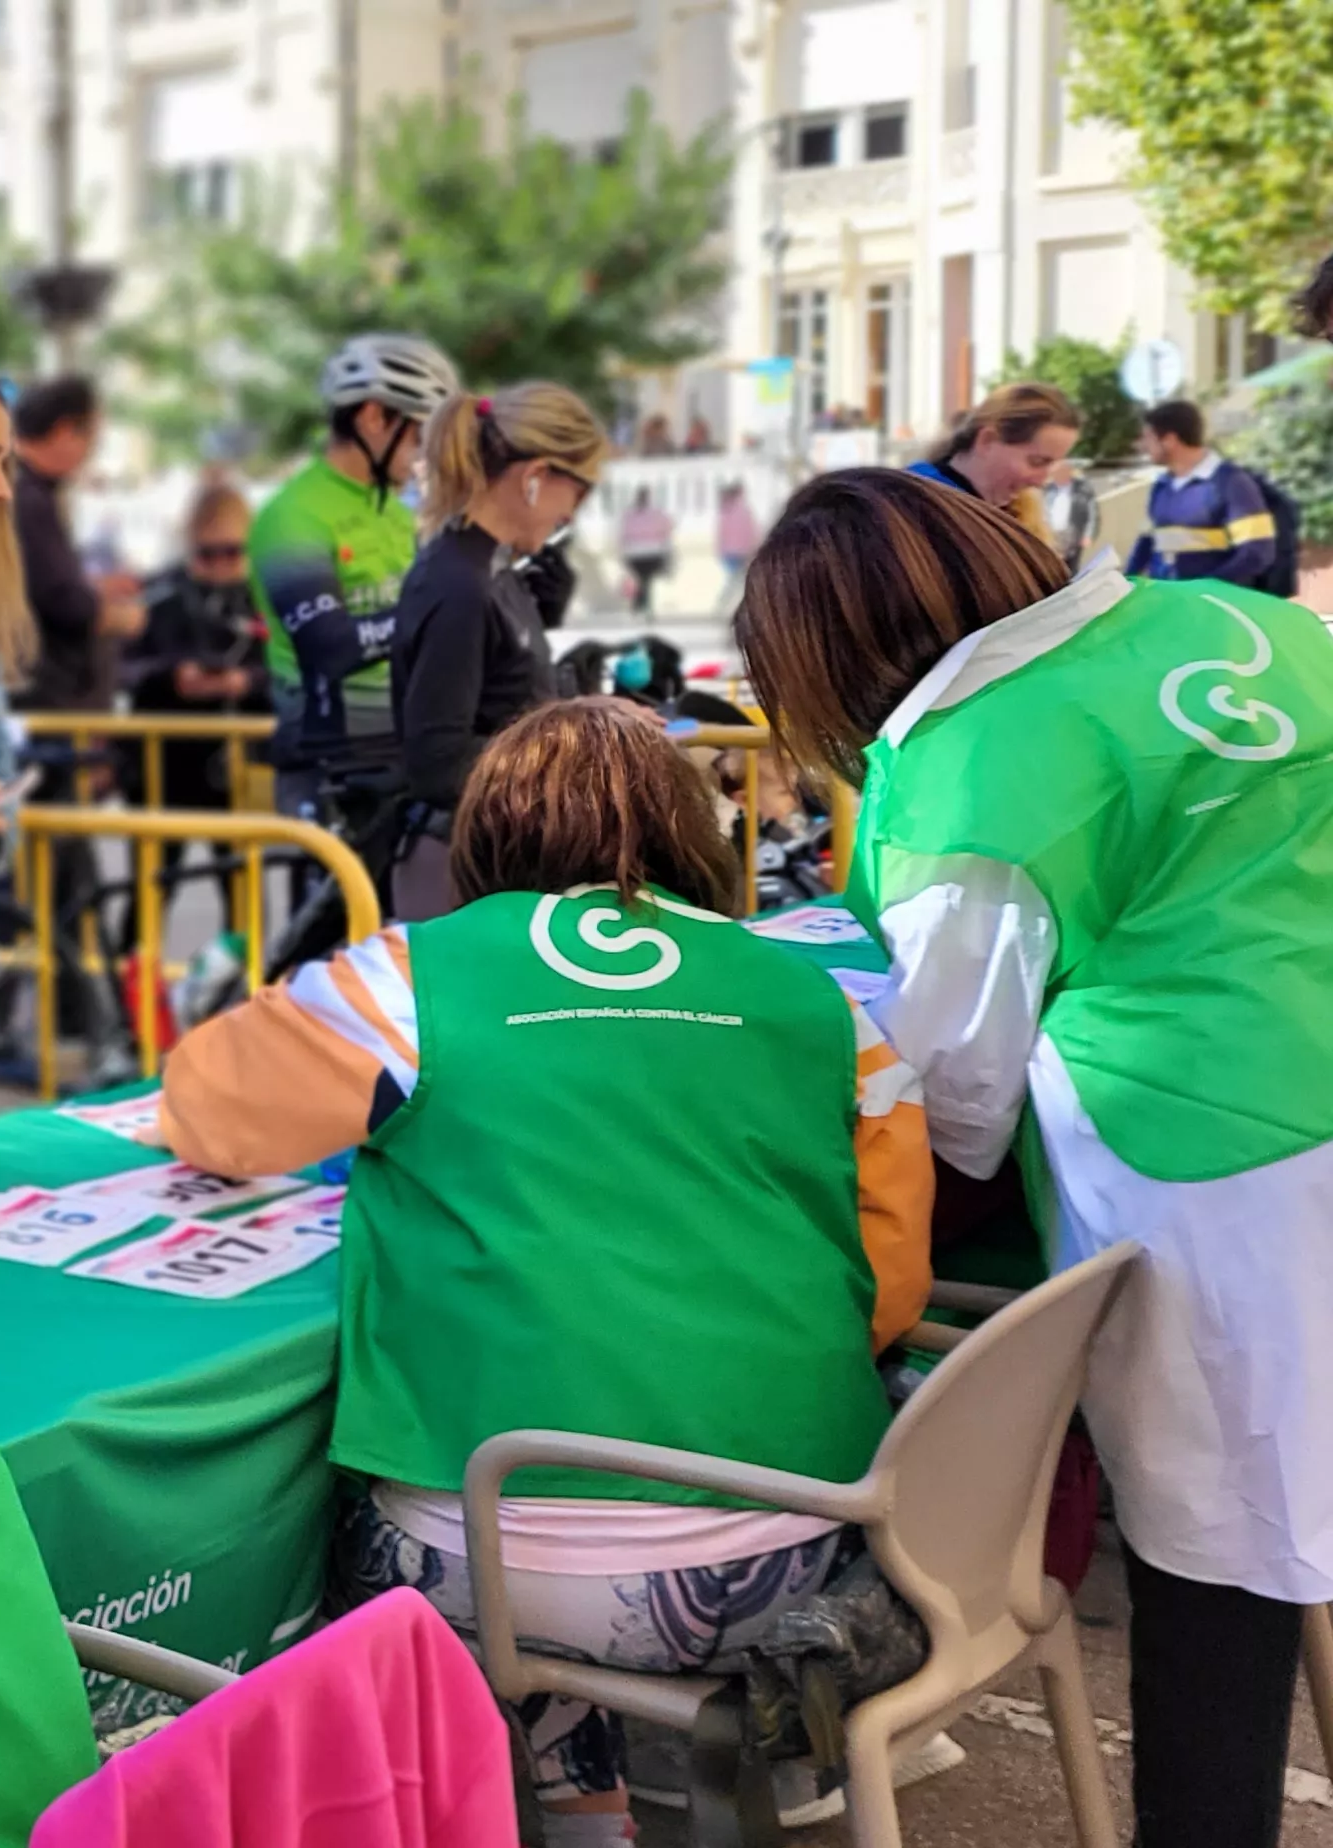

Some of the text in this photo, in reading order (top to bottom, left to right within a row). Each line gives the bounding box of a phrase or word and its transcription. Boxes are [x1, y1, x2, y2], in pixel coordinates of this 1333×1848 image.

[505, 1008, 575, 1026] ASOCIACIÓN
[635, 1008, 683, 1021] CONTRA
[144, 1236, 271, 1284] 1017
[61, 1568, 192, 1631] ciación
